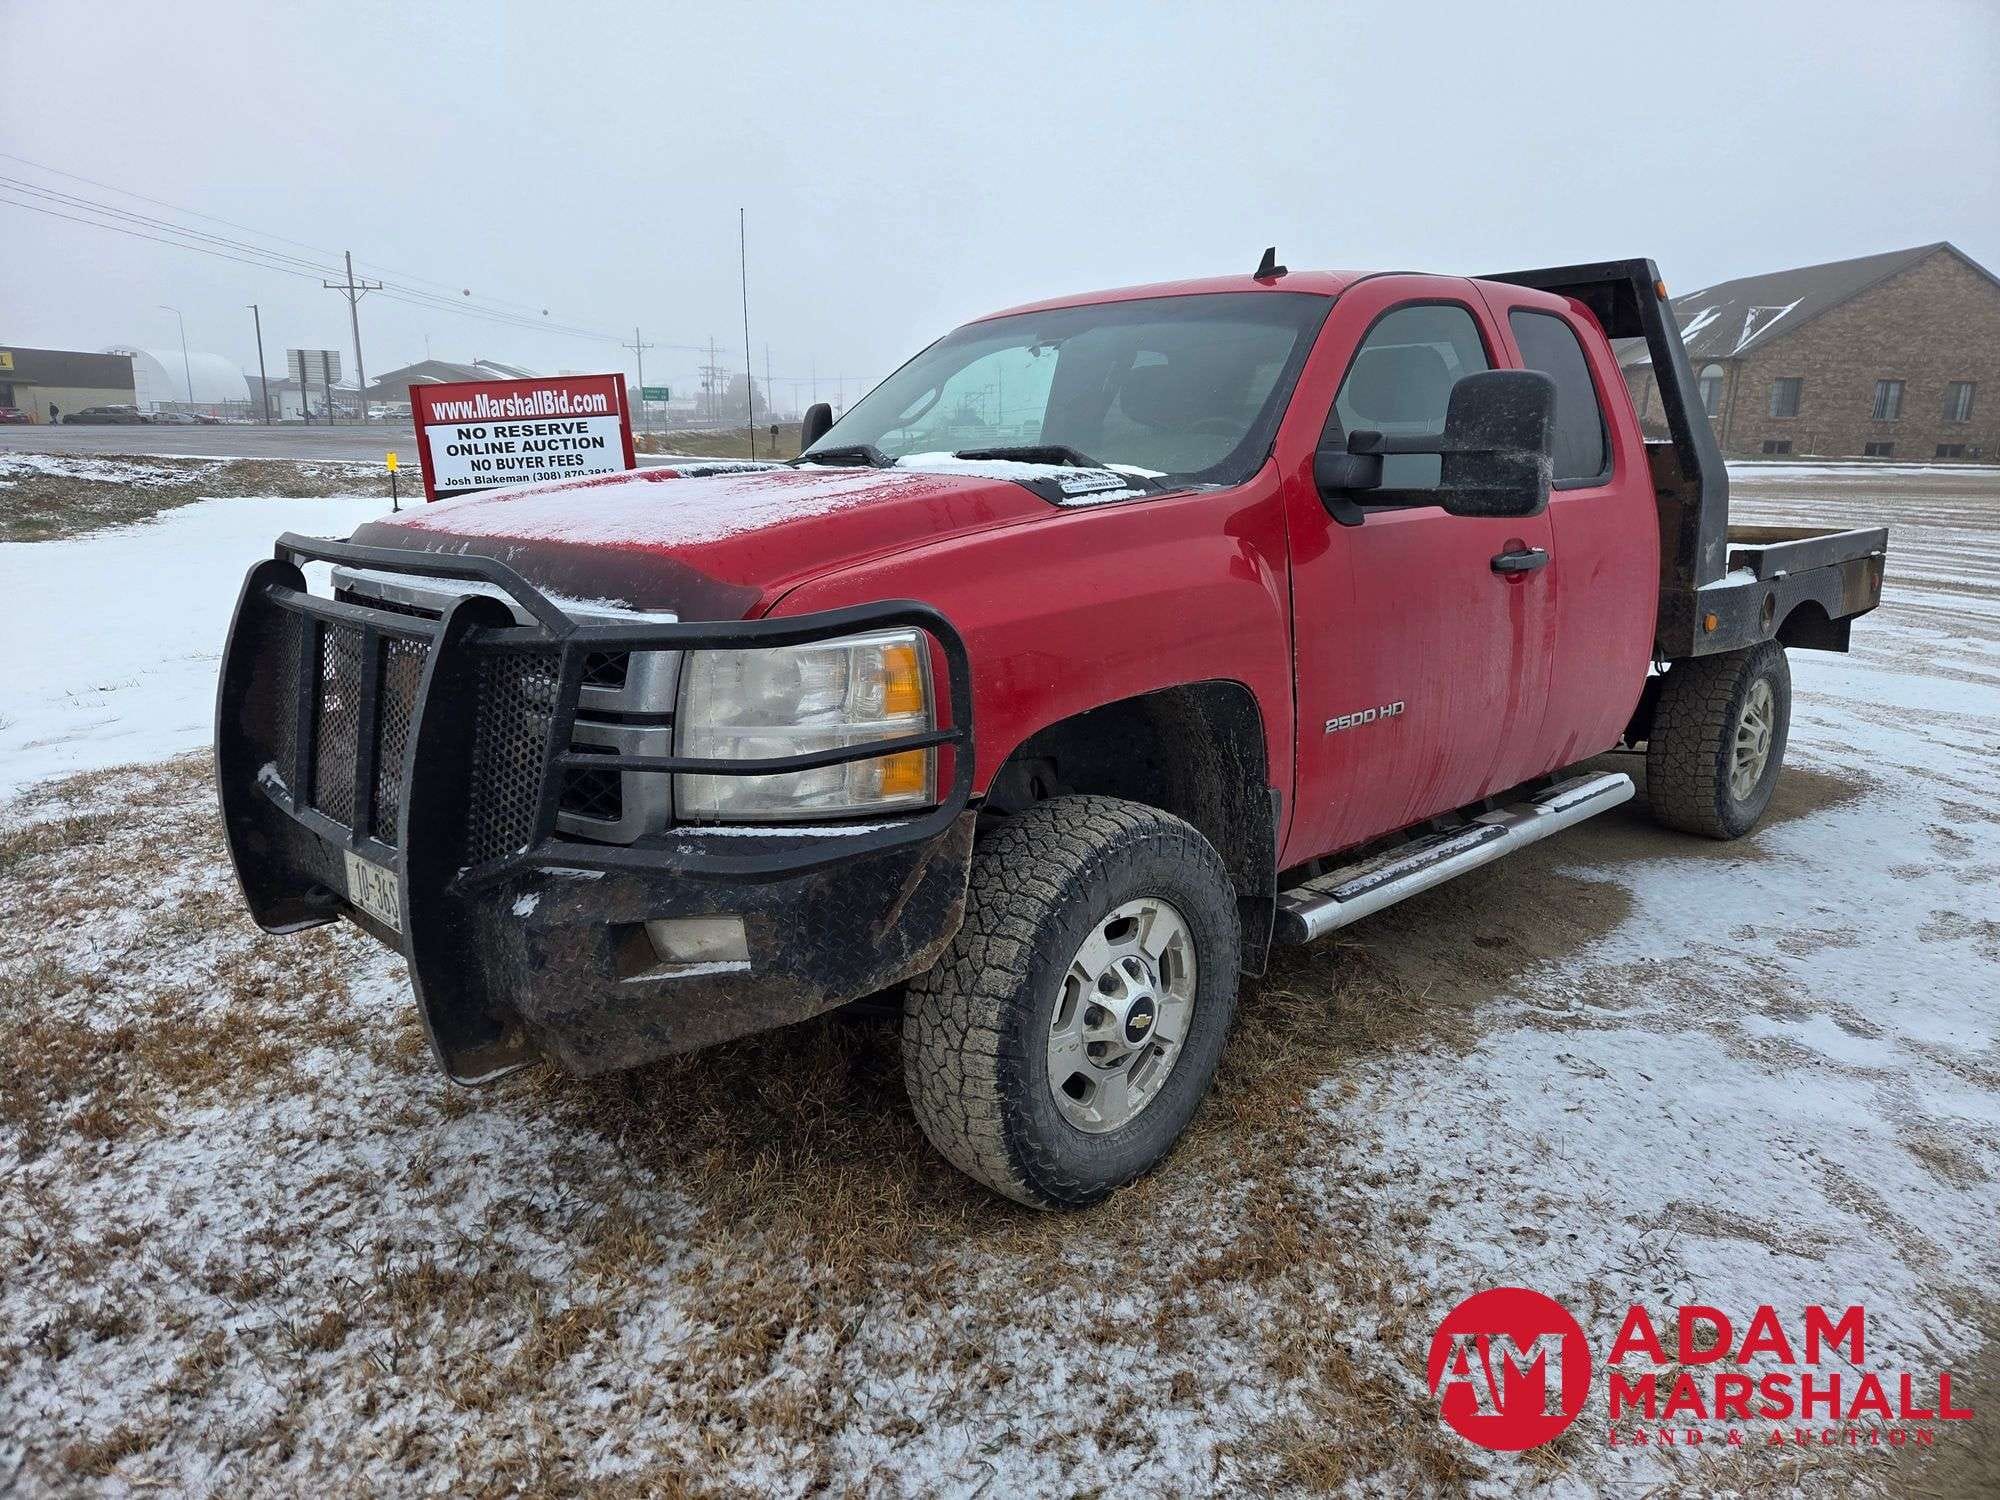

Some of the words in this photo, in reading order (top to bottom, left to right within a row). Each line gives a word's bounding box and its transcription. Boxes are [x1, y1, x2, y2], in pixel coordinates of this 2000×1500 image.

[431, 390, 608, 420] www.MarshallBid.com
[457, 427, 487, 440] NO
[494, 422, 589, 438] RESERVE
[446, 441, 515, 456] ONLINE
[522, 436, 605, 452] AUCTION
[470, 459, 491, 471] NO
[496, 456, 544, 470] BUYER
[549, 454, 584, 467] FEES
[445, 476, 471, 486] Josh
[474, 474, 529, 485] Blakeman
[533, 471, 561, 482] (308)
[1325, 708, 1377, 735] 2500
[1380, 701, 1405, 720] HD
